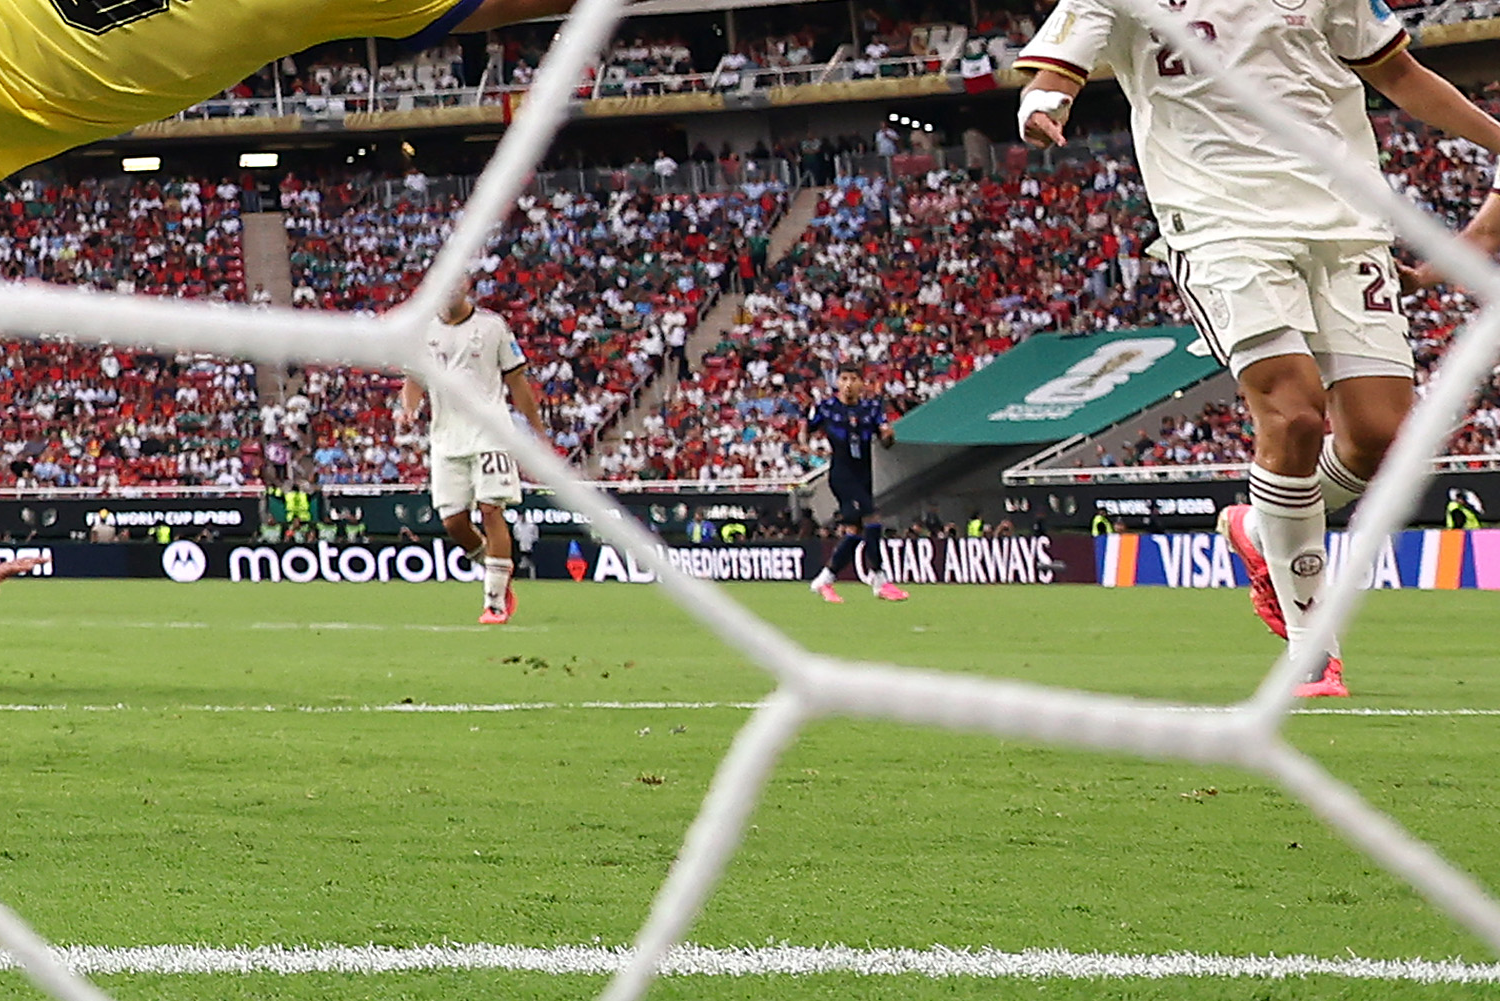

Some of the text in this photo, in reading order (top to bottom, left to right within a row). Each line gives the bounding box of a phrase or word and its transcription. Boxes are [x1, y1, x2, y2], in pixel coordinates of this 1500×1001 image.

[481, 452, 509, 475] 20
[229, 538, 485, 582] motorola
[943, 535, 1054, 585] AIRWAYS
[1152, 533, 1237, 588] VISA
